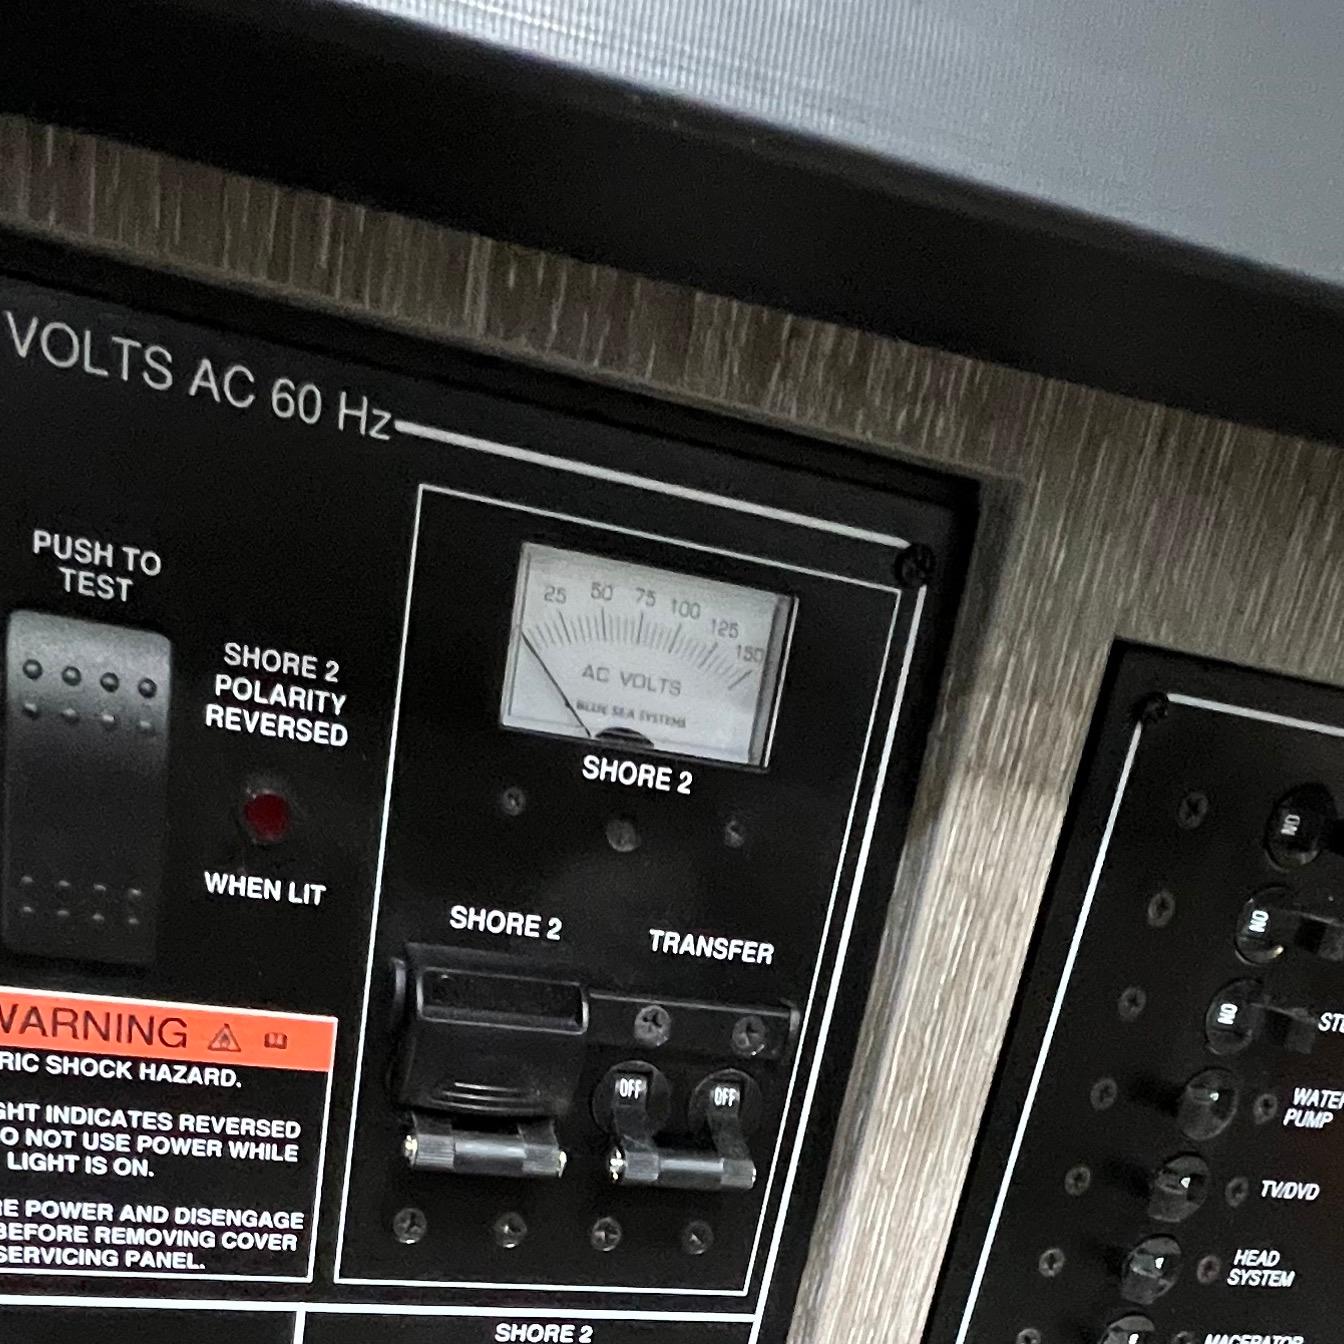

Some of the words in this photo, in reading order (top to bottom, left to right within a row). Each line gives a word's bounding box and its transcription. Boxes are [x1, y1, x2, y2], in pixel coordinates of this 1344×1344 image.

[6, 311, 173, 391] VOLTS
[188, 358, 255, 408] AC
[270, 376, 321, 425] 60
[338, 391, 391, 440] Hz
[32, 529, 114, 570] PUSH
[122, 546, 162, 577] TO
[58, 566, 132, 602] TEST
[544, 586, 567, 604] 25
[591, 582, 613, 601] 50
[635, 587, 656, 607] 75
[672, 598, 701, 620] 100
[711, 618, 739, 639] 125
[223, 642, 317, 680] SHORE
[325, 659, 340, 683] 2
[737, 644, 764, 663] 150
[582, 665, 610, 683] AC
[620, 671, 682, 696] VOLTS
[214, 674, 347, 715] POLARITY
[206, 704, 348, 748] REVERSED
[583, 755, 672, 792] SHORE
[677, 772, 693, 795] 2
[204, 871, 283, 901] WHEN
[288, 882, 326, 906] LIT
[450, 905, 540, 940] SHORE
[547, 919, 562, 941] 2
[649, 929, 775, 965] TRANSFER
[46, 1056, 133, 1081] SHOCK
[139, 1063, 241, 1088] HAZARD.
[620, 1079, 642, 1097] OFF
[714, 1087, 736, 1107] OFF
[46, 1106, 172, 1131] INDICATES
[179, 1114, 301, 1140] REVERSED
[1284, 1110, 1333, 1128] PUMP
[26, 1128, 76, 1149] NOT
[83, 1132, 130, 1153] USE
[138, 1135, 222, 1157] POWER
[229, 1142, 298, 1162] WHILE
[7, 1153, 79, 1175] LIGHT
[86, 1157, 107, 1175] IS
[114, 1158, 154, 1178] ON.
[1261, 1180, 1319, 1200] TV/DVD
[25, 1200, 113, 1223] POWER
[120, 1205, 168, 1225] AND
[176, 1207, 304, 1230] DISENGAGE
[94, 1226, 215, 1249] REMOVING
[221, 1231, 297, 1252] COVER
[125, 1249, 205, 1270] PANEL.
[1234, 1250, 1279, 1266] HEAD
[1227, 1270, 1295, 1287] SYSTEM
[495, 1324, 574, 1343] SHORE
[579, 1325, 593, 1344] 2
